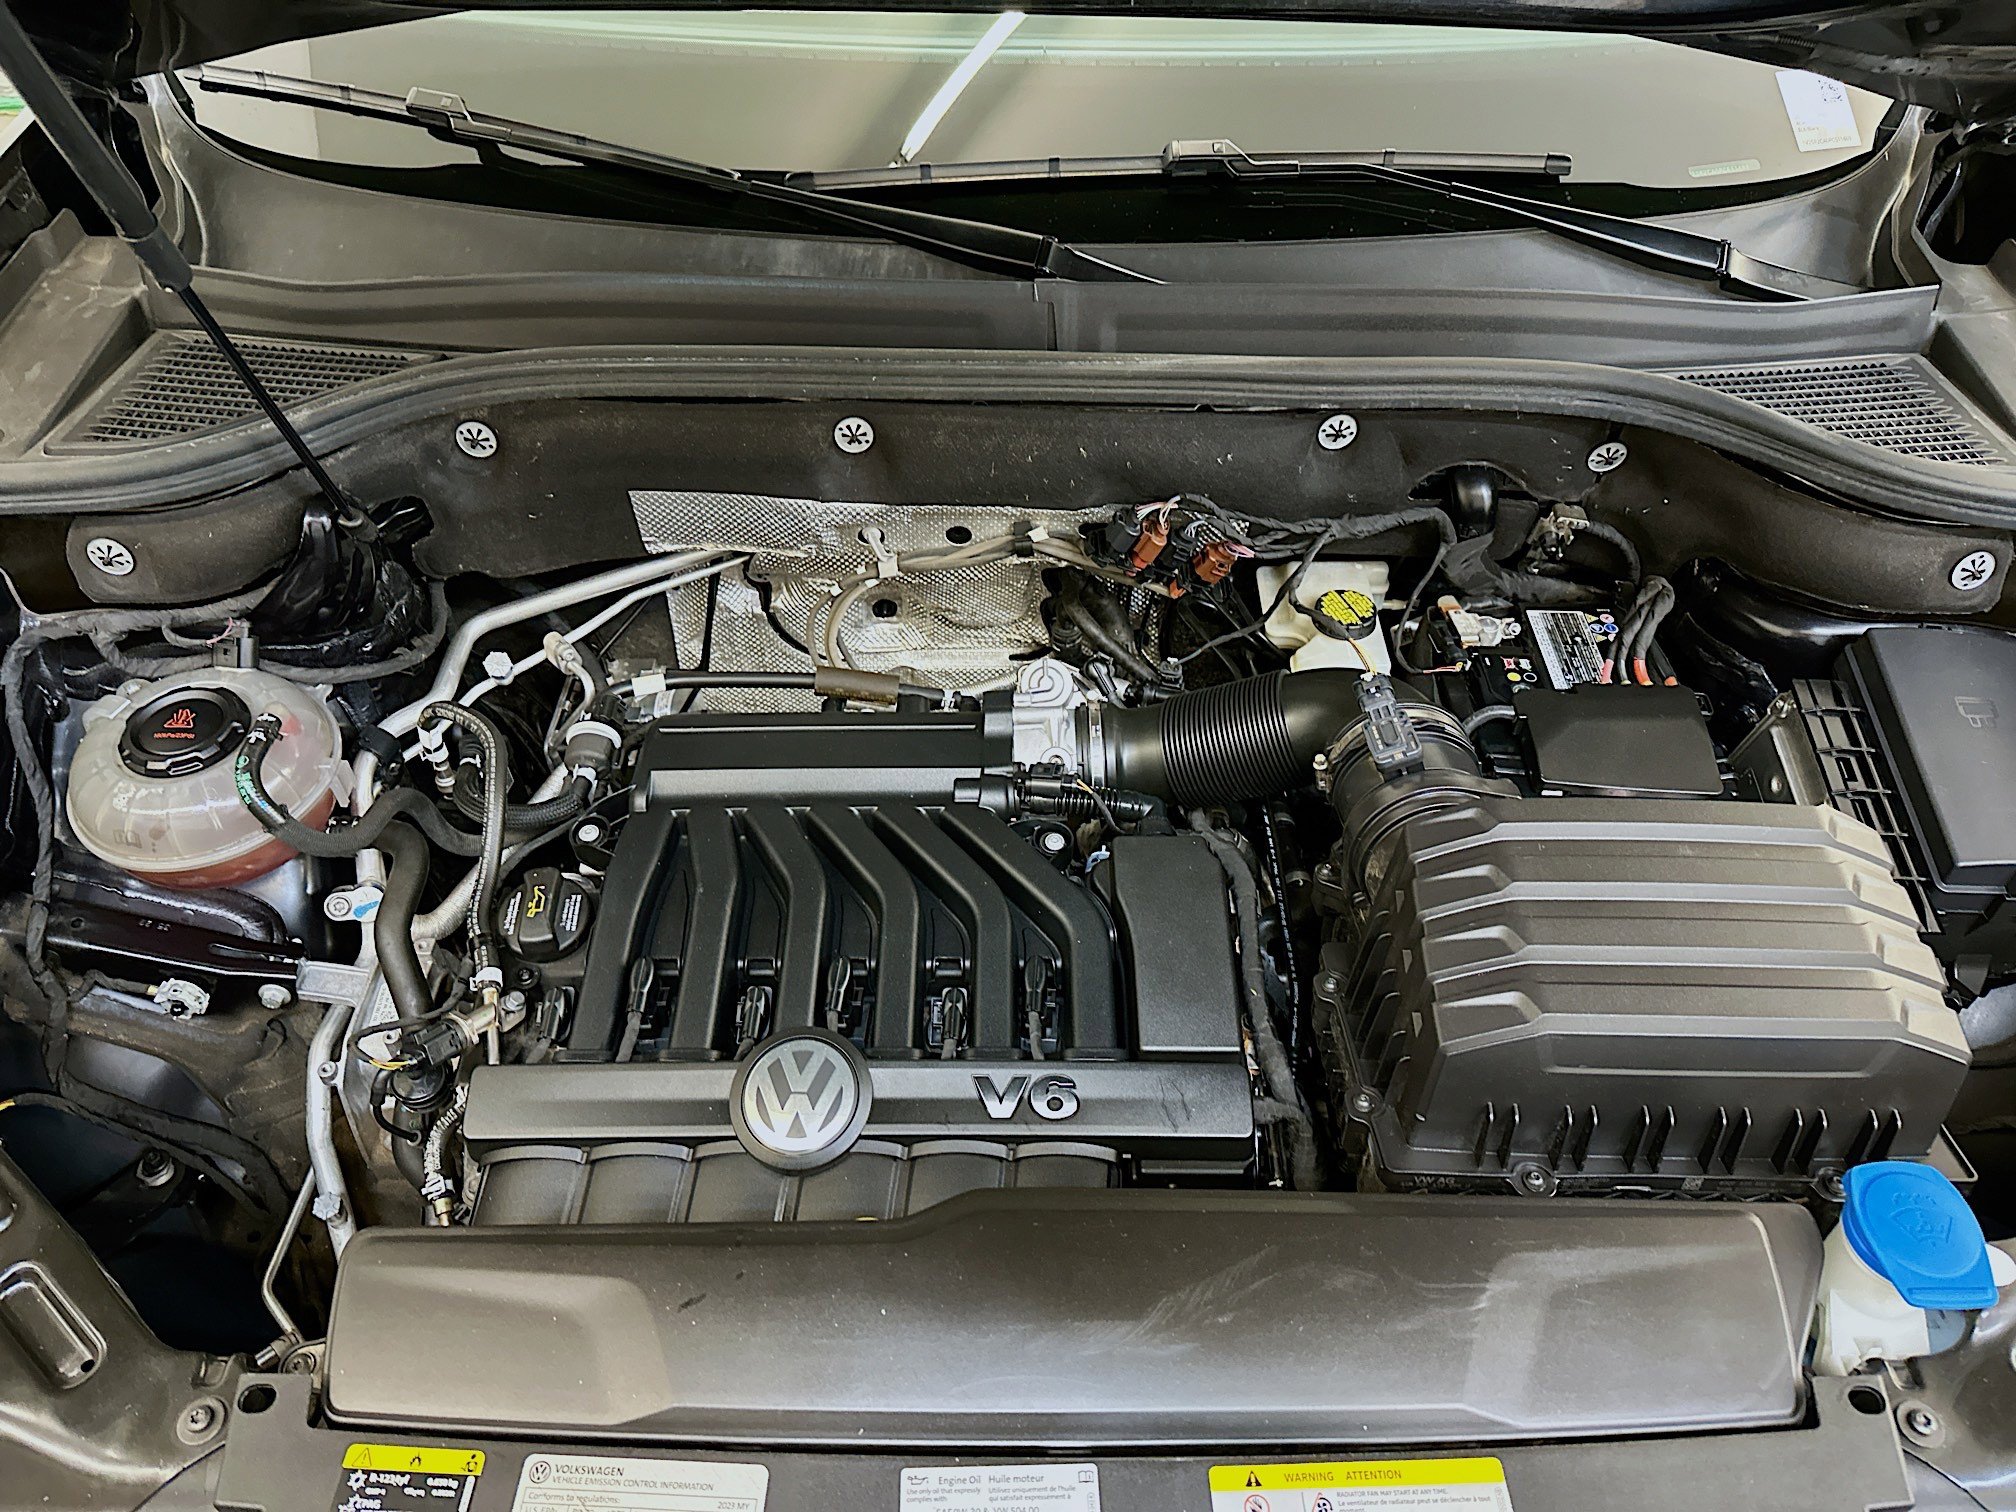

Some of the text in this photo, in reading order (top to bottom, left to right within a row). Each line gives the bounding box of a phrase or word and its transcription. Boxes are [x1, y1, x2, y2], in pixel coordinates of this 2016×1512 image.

[971, 1073, 1081, 1120] V6
[555, 1464, 625, 1476] VOLKSWAGEN
[1284, 1469, 1403, 1482] WARNING ATTENTION
[552, 1476, 714, 1491] VEHICLE EMISSION CONTROL INFORMATION
[938, 1475, 981, 1486] Engine Oil
[989, 1474, 1044, 1484] Huile moteur
[528, 1491, 565, 1501] Conforms
[566, 1494, 575, 1502] to
[954, 1487, 981, 1495] expressly
[718, 1501, 750, 1510] 2023 MY
